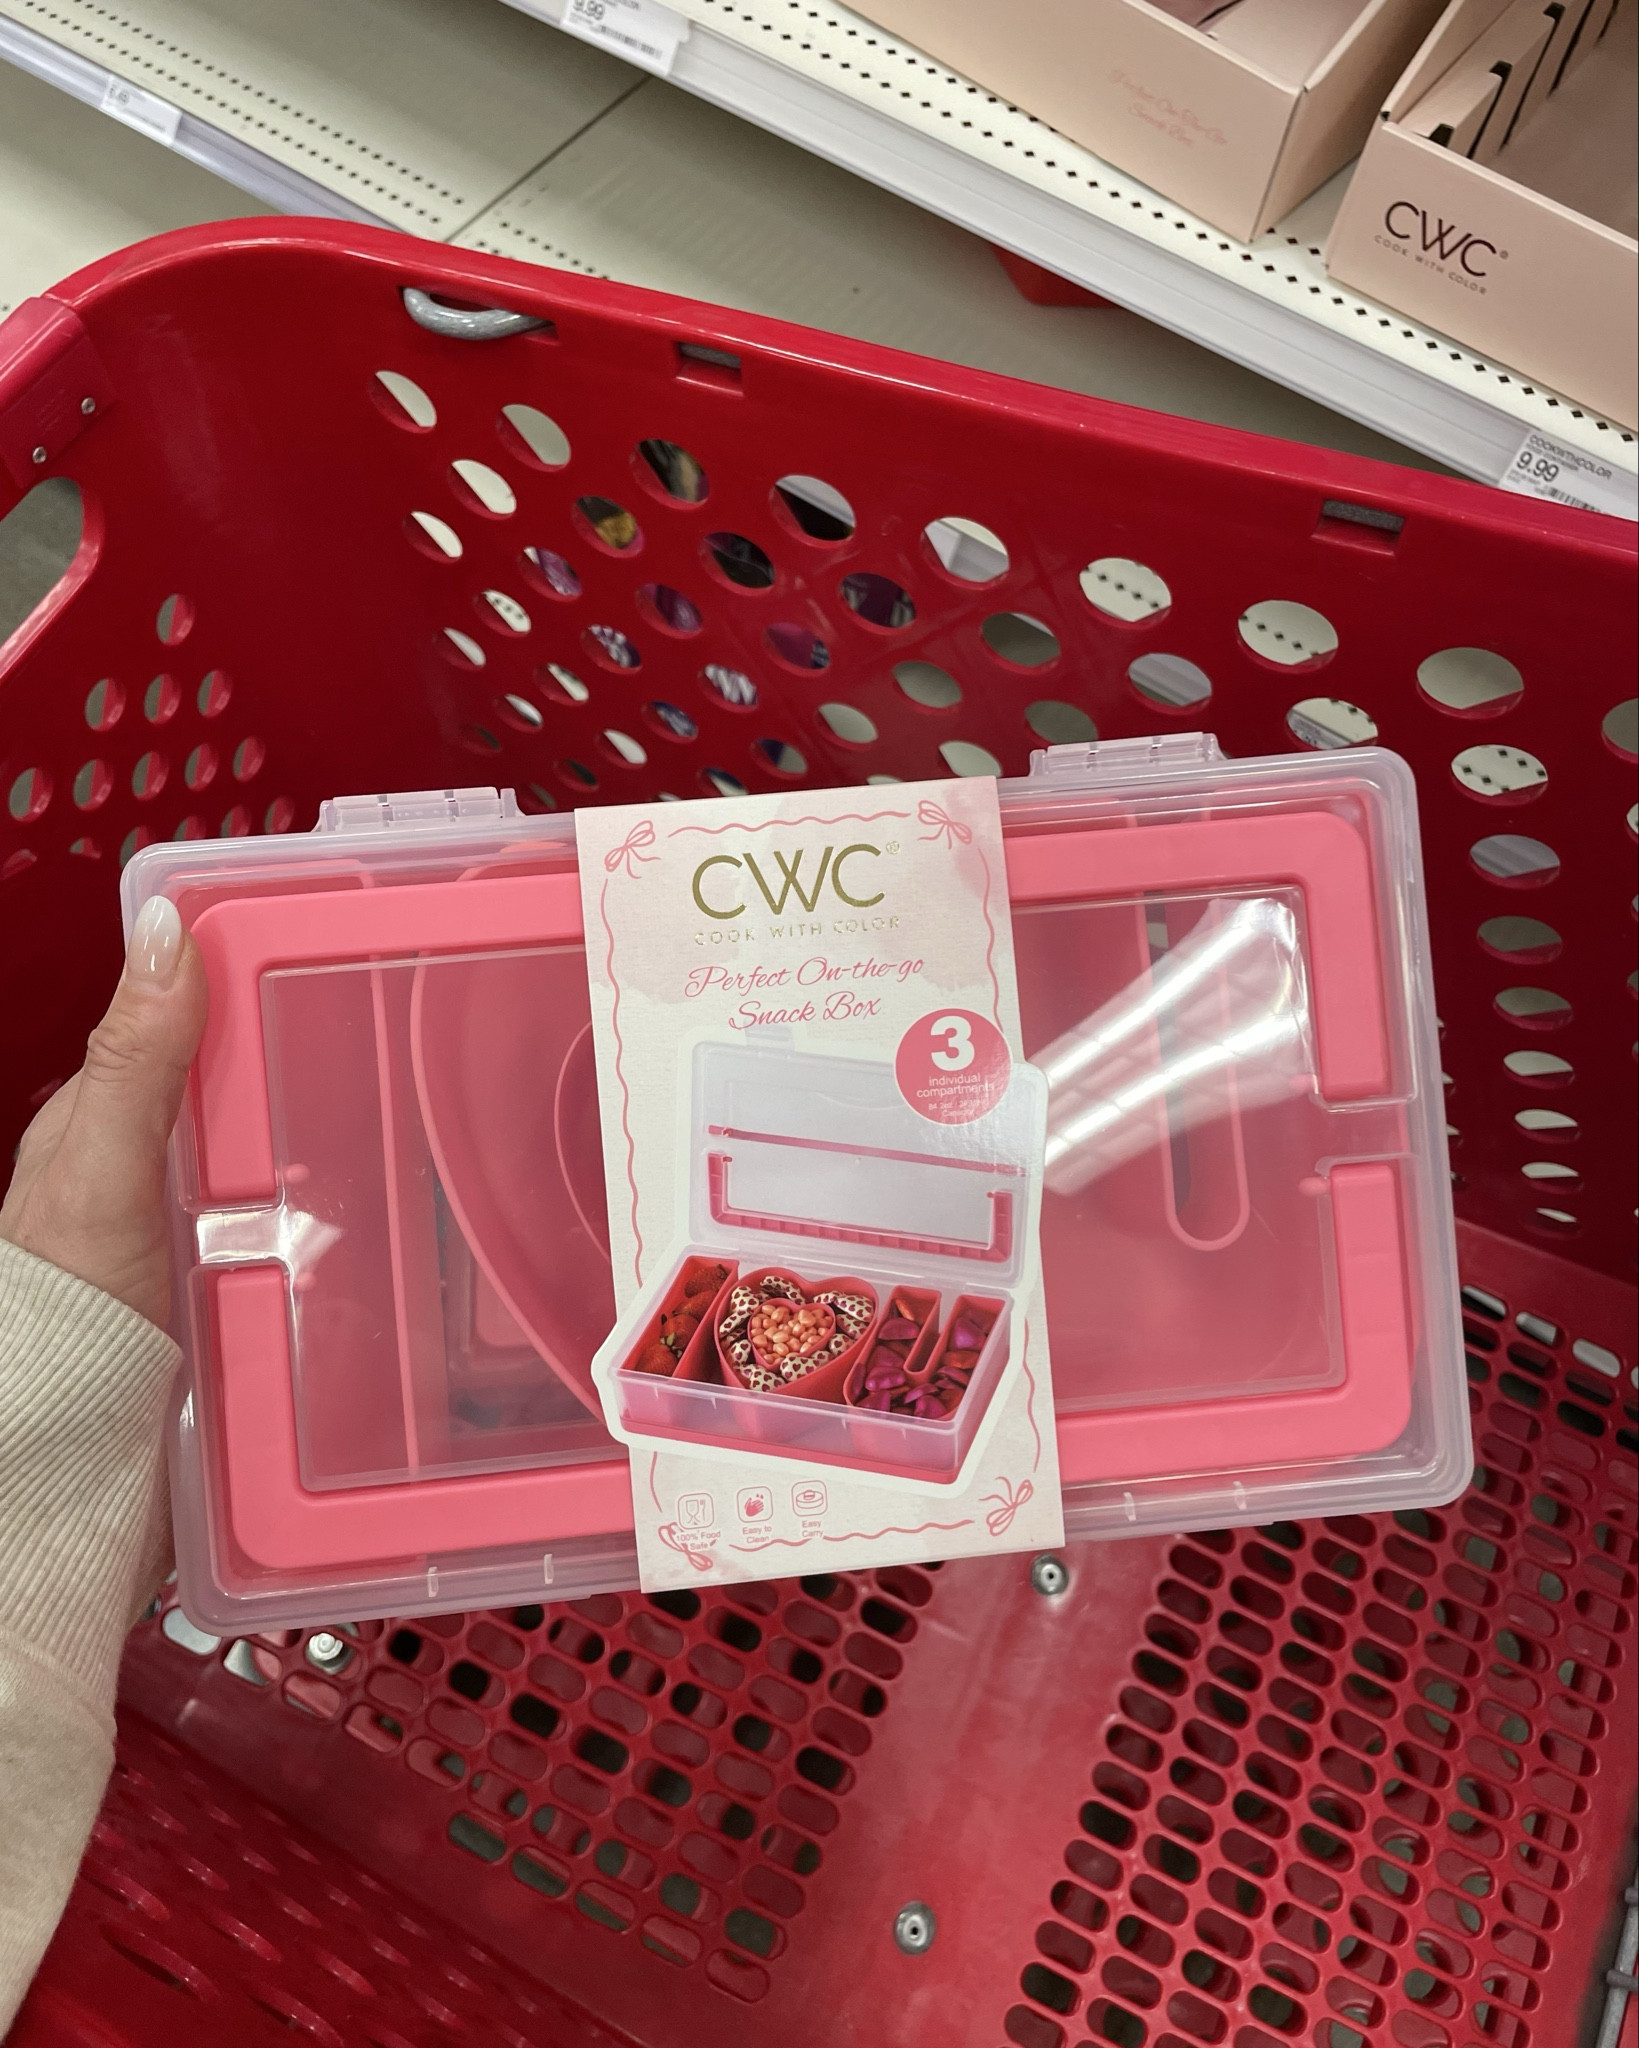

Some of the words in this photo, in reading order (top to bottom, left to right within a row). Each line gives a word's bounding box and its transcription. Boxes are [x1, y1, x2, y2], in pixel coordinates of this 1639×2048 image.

[1374, 235, 1409, 256] COOK
[1415, 254, 1444, 273] WITH
[1448, 271, 1487, 294] COLOR
[1516, 450, 1560, 482] 9.99
[694, 927, 756, 946] COOK
[769, 921, 823, 939] WITH
[833, 915, 900, 934] COLOR
[684, 965, 792, 998] Perfect
[796, 956, 925, 986] On-the-go
[728, 1000, 816, 1030] Snack
[822, 990, 882, 1020] Box
[930, 1015, 976, 1072] 3
[928, 1072, 981, 1087] individual
[916, 1082, 995, 1098] compartments
[742, 1526, 762, 1535] Easy
[763, 1525, 773, 1533] to
[801, 1520, 822, 1529] Easy
[676, 1533, 699, 1542] 100%
[700, 1530, 721, 1539] Food
[746, 1535, 770, 1544] Clean
[801, 1530, 824, 1539] Carry
[690, 1541, 709, 1551] Safe
